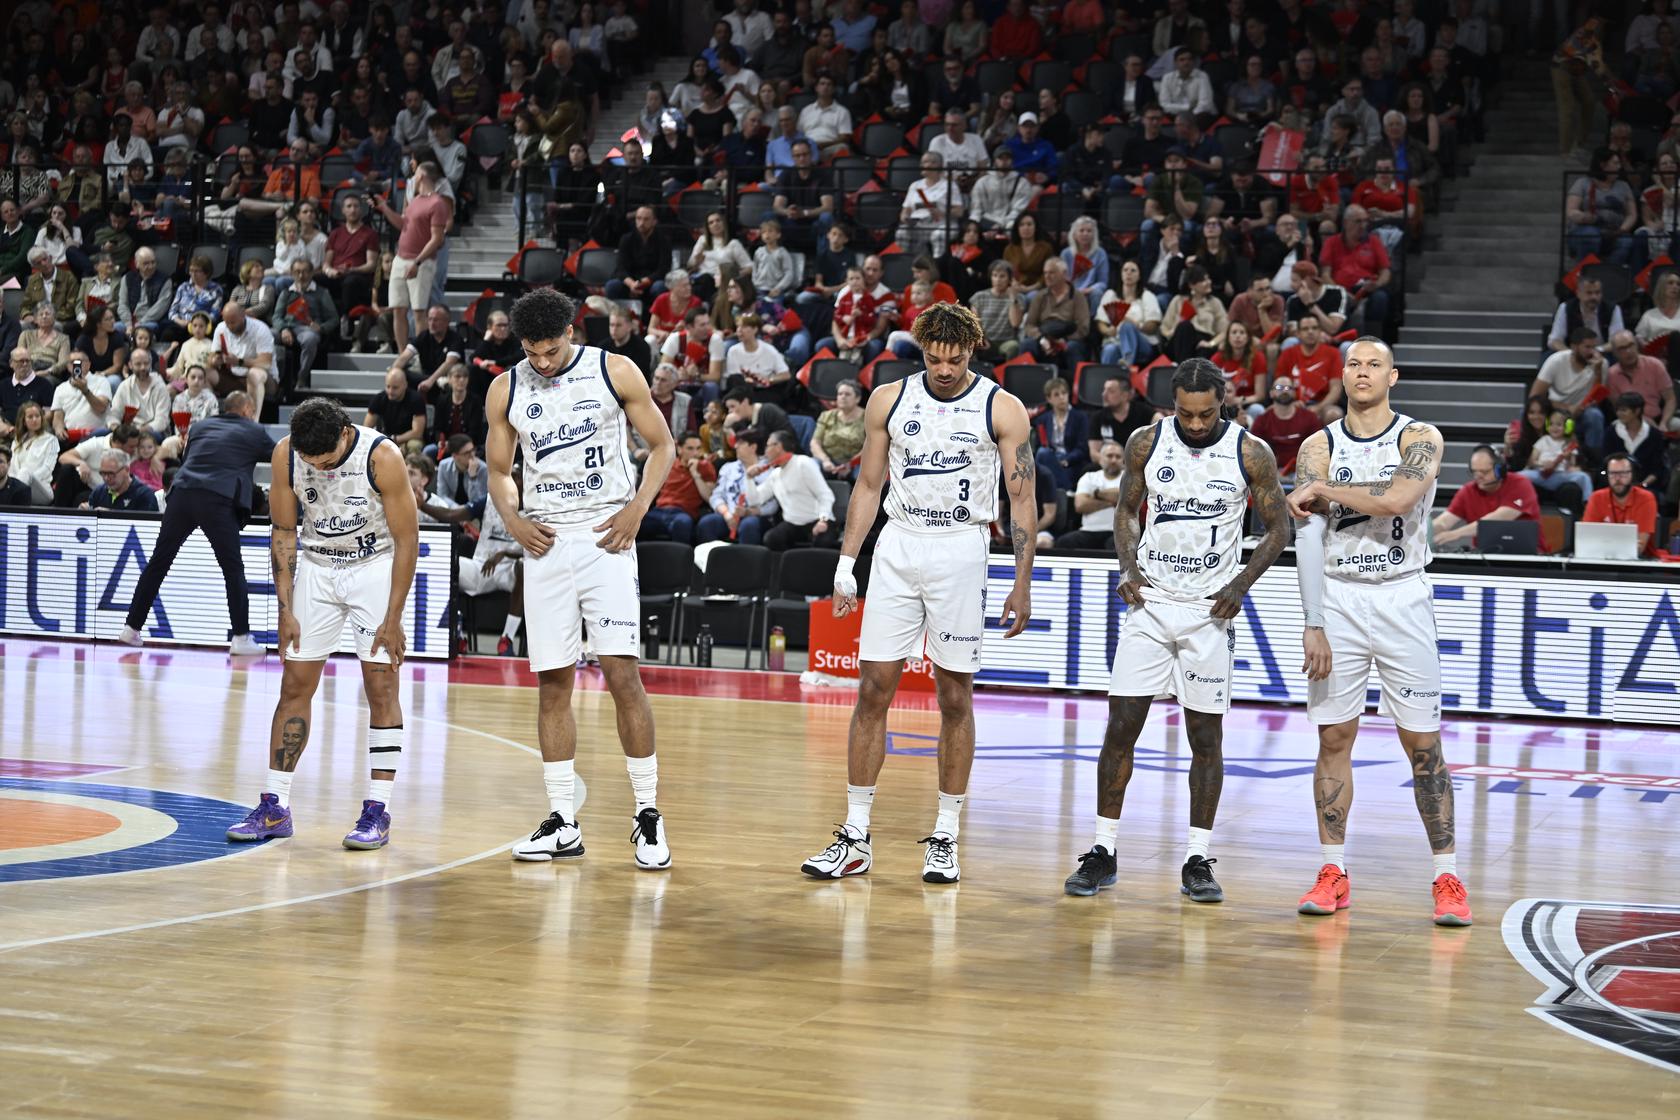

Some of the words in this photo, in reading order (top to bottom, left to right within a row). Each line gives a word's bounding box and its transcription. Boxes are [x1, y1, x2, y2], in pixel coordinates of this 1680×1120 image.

[530, 417, 598, 451] Saint-Quentin
[584, 446, 605, 469] 21
[902, 448, 972, 469] Saint-Quentin
[535, 481, 586, 494] E.Leclerc
[561, 489, 587, 498] DRIVE
[958, 479, 970, 502] 3
[1154, 494, 1228, 515] Saint-Quentin
[925, 518, 952, 527] DRIVE
[1391, 516, 1404, 541] 8
[1210, 524, 1218, 547] 1
[1148, 550, 1202, 566] E.Leclerc
[1358, 564, 1387, 572] DRIVE
[1174, 565, 1201, 573] DRIVE
